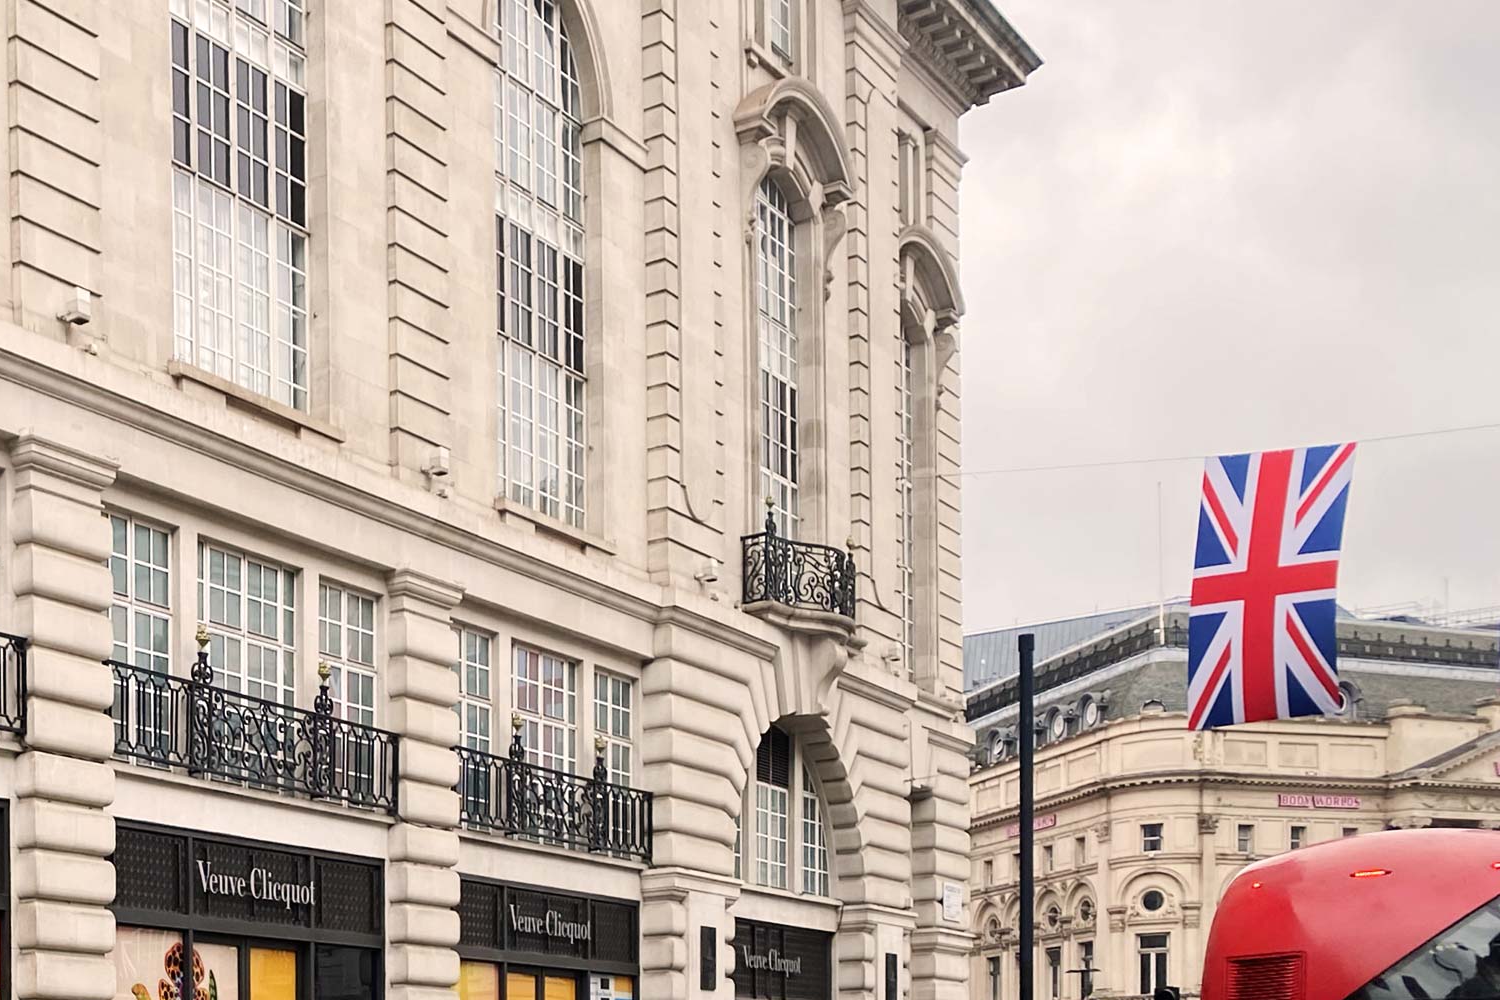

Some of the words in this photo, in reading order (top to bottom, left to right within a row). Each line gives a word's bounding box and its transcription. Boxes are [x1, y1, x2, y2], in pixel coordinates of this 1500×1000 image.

[196, 859, 246, 897] Veuve
[250, 867, 316, 910] Clicquot
[509, 903, 543, 934] Veuve
[545, 909, 591, 945] Clicquot
[742, 944, 768, 970] Veuve
[768, 948, 802, 978] Clicquot
